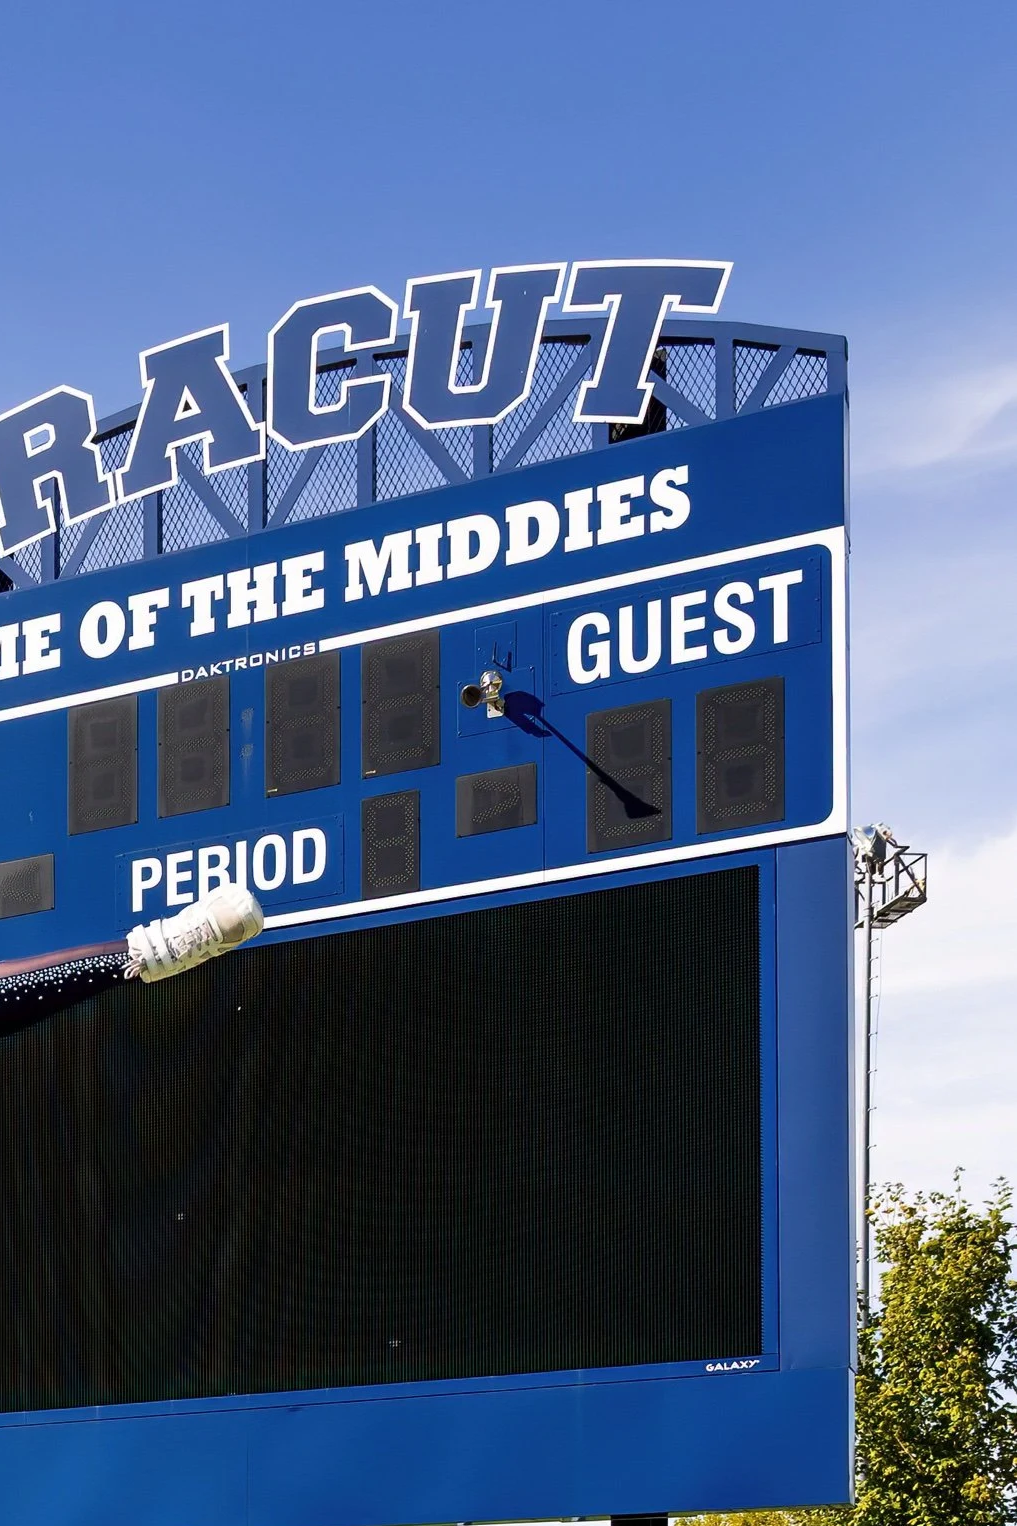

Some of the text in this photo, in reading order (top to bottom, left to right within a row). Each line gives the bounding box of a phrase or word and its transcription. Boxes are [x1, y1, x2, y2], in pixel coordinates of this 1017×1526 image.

[78, 588, 169, 660] OF
[181, 551, 325, 638] THE
[344, 465, 691, 602] MIDDIES
[181, 641, 316, 683] DAKTRONICS
[566, 569, 803, 685] GUEST
[131, 827, 327, 913] PERIOD
[705, 1359, 757, 1372] GALAXY
